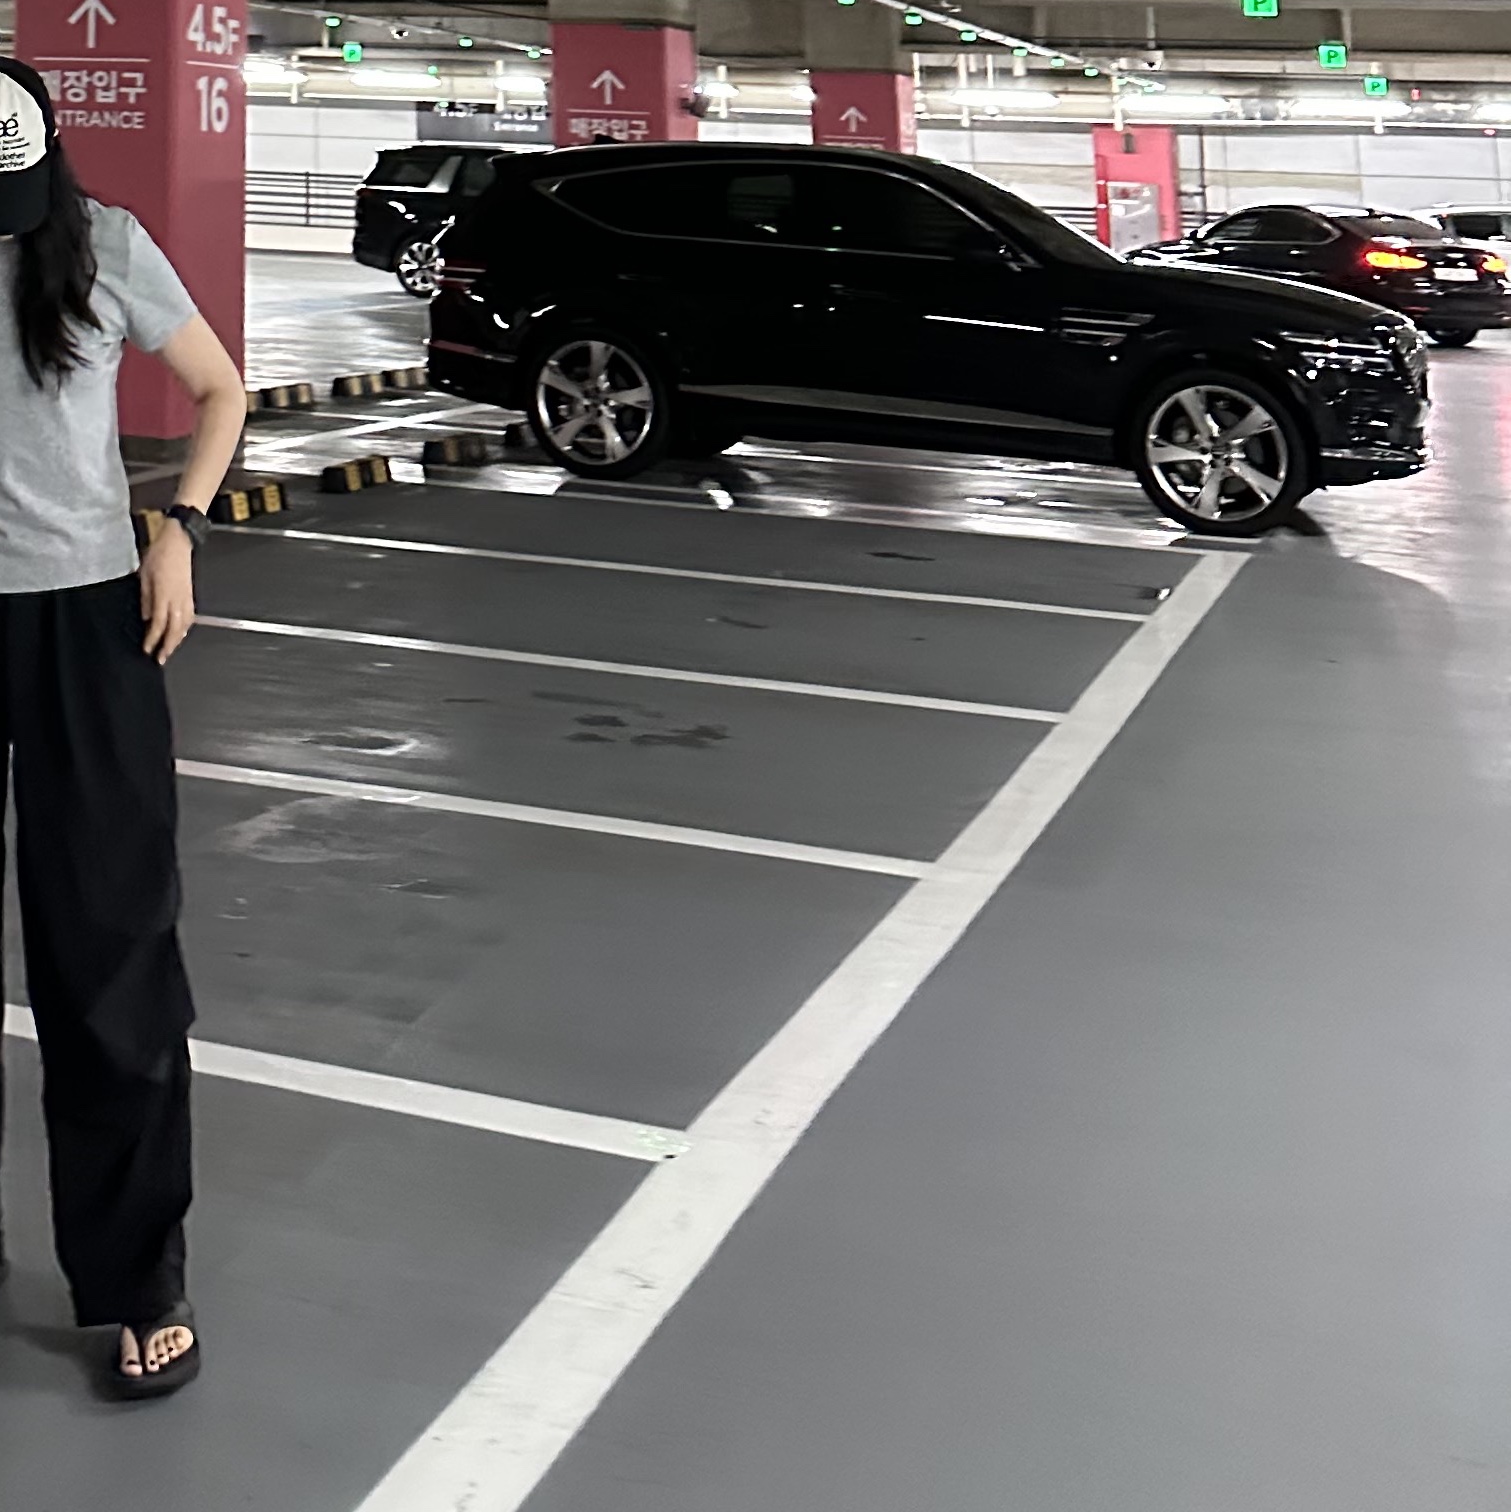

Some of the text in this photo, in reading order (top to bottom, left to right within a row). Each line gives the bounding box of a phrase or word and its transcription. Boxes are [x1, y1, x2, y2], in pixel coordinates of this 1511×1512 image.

[186, 3, 240, 55] 4.5F
[1327, 50, 1337, 63] P
[196, 76, 229, 133] 16
